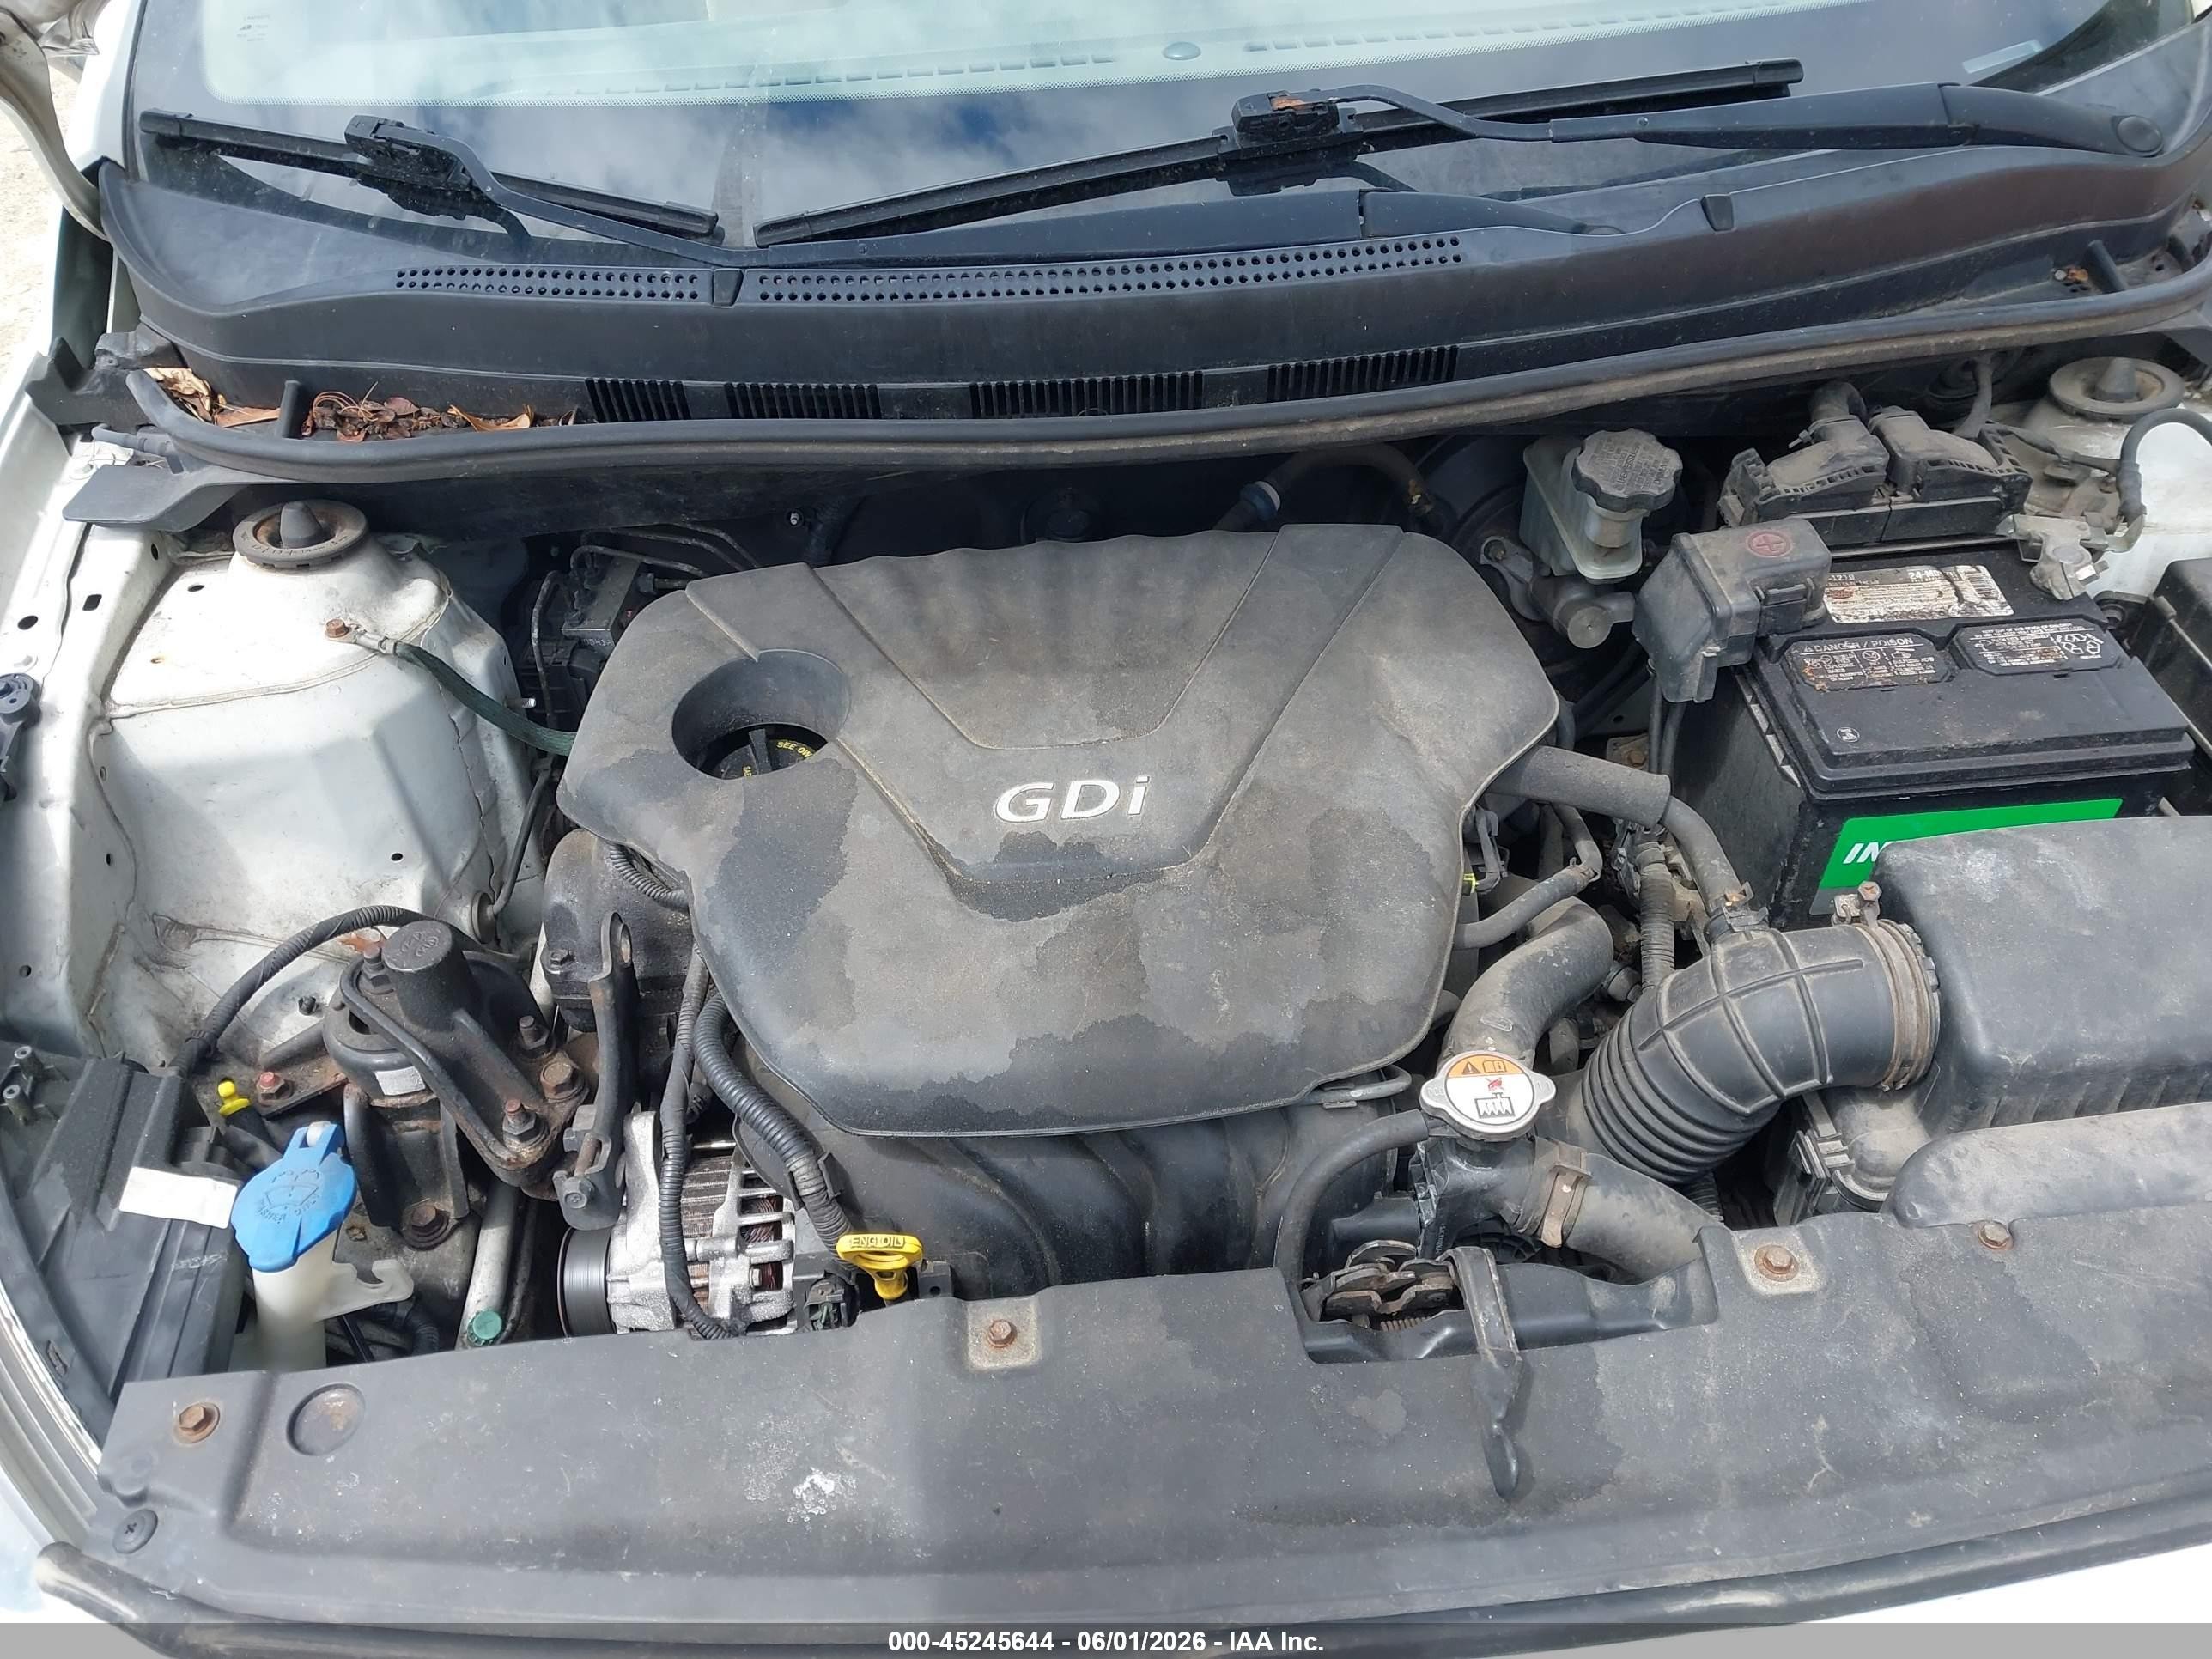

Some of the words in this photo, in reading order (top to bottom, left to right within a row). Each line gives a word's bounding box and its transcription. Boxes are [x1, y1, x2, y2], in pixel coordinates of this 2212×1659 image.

[1870, 637, 1914, 647] POISON
[776, 741, 797, 750] SEE
[994, 775, 1151, 823] GDi
